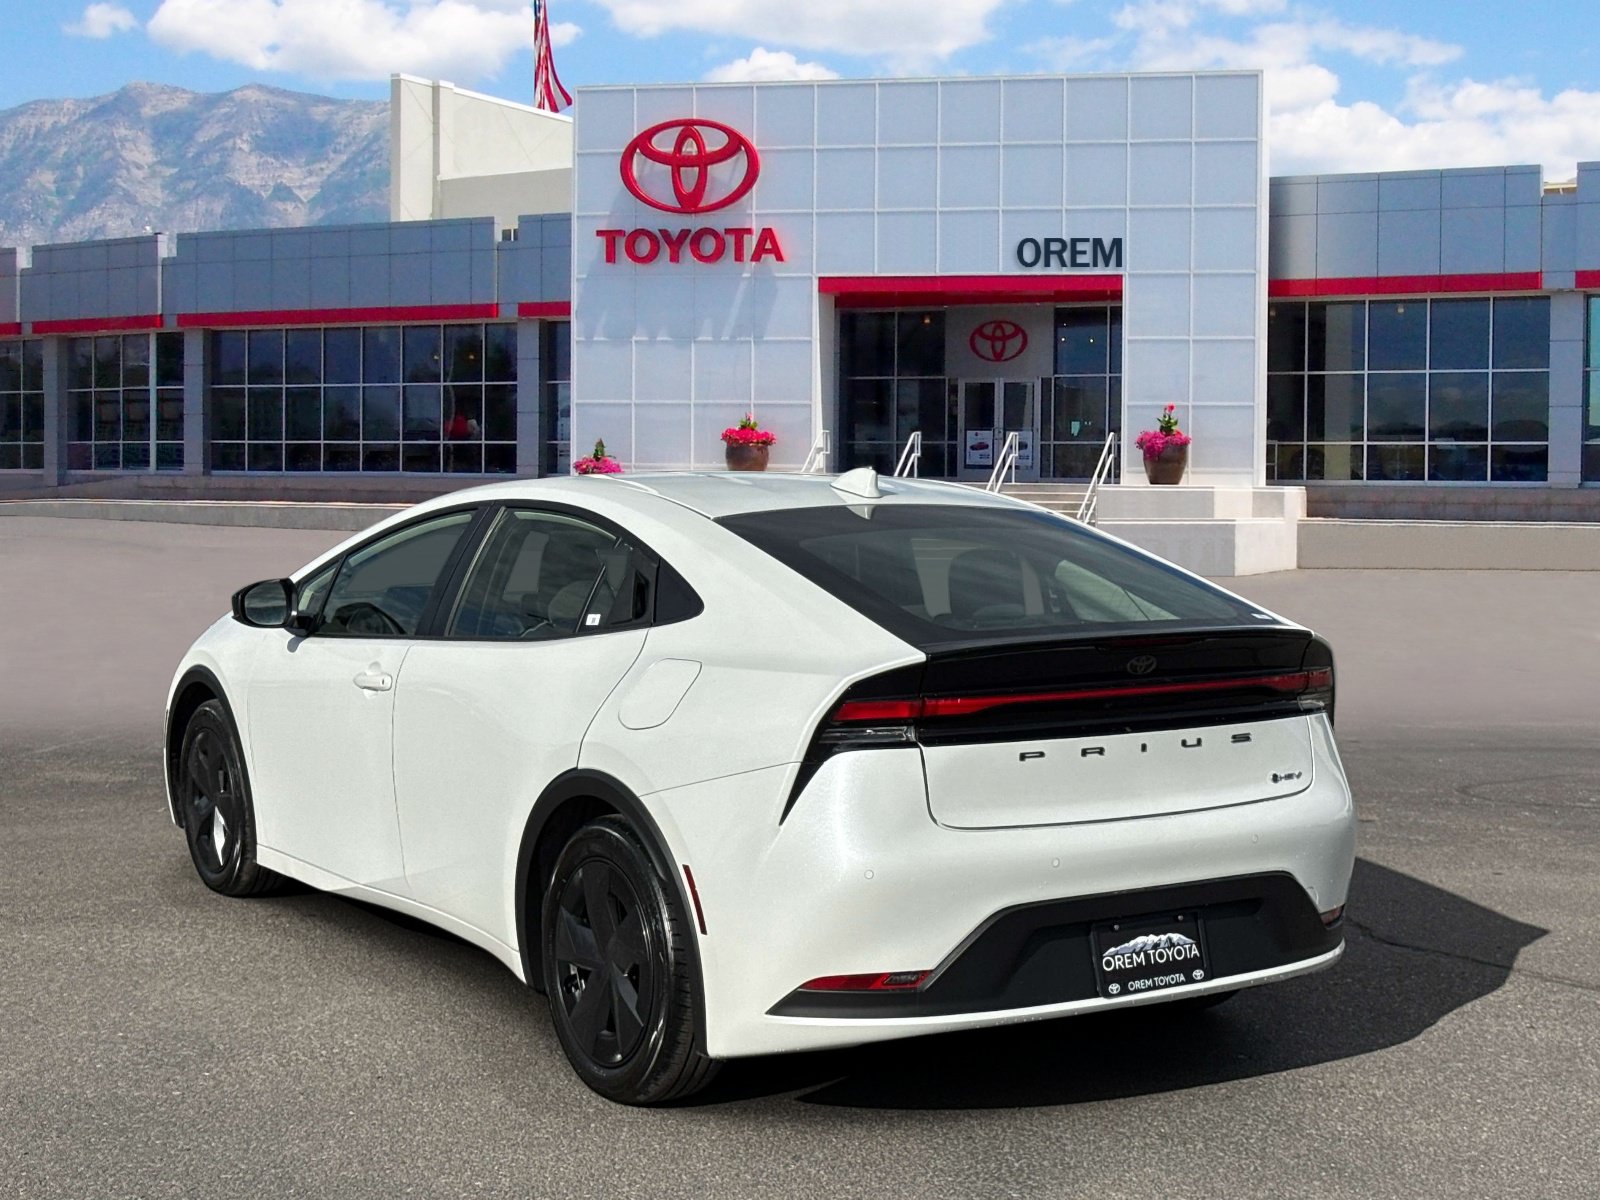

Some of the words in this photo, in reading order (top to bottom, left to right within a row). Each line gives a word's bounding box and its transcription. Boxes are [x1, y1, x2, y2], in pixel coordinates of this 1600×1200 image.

[596, 227, 785, 264] TOYOTA
[1017, 237, 1123, 268] OREM
[1019, 731, 1252, 762] PRIUS
[1102, 952, 1146, 972] OREM
[1147, 943, 1200, 965] TOYOTA
[1128, 979, 1153, 991] OREM
[1155, 973, 1186, 987] TOYOTA
